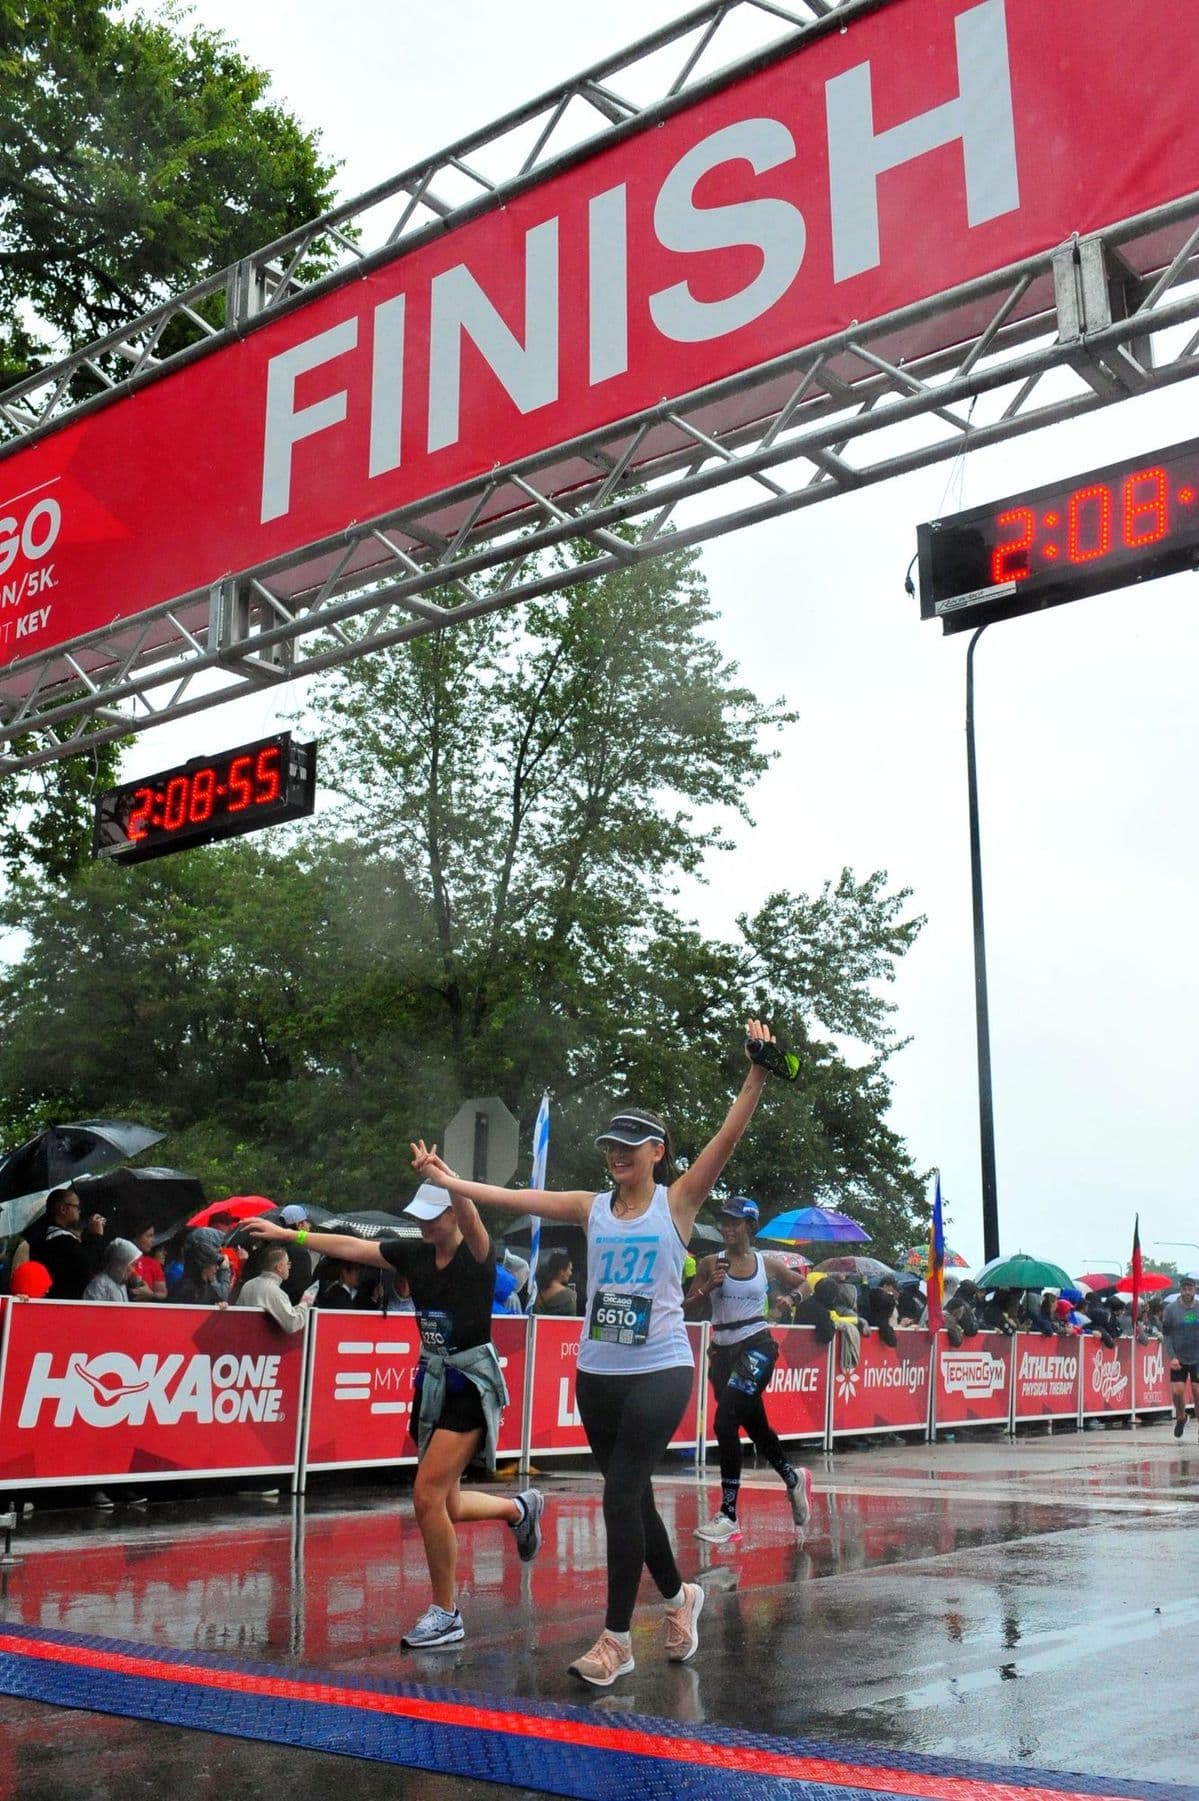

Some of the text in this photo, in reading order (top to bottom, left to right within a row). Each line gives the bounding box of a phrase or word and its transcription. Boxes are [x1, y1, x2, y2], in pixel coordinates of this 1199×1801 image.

[261, 1, 1021, 524] FINISH
[16, 605, 52, 638] KEY
[596, 1308, 637, 1326] 6610
[422, 1331, 445, 1345] 230
[212, 1355, 280, 1388] ONE
[374, 1367, 402, 1391] MY
[863, 1360, 925, 1394] invisalign
[943, 1359, 1003, 1389] TECHNOGYM
[1019, 1352, 1077, 1380] ATHLETICO
[18, 1352, 214, 1428] HOKA
[1022, 1381, 1073, 1397] PHYSICAL THERAPY
[214, 1389, 282, 1424] ONE
